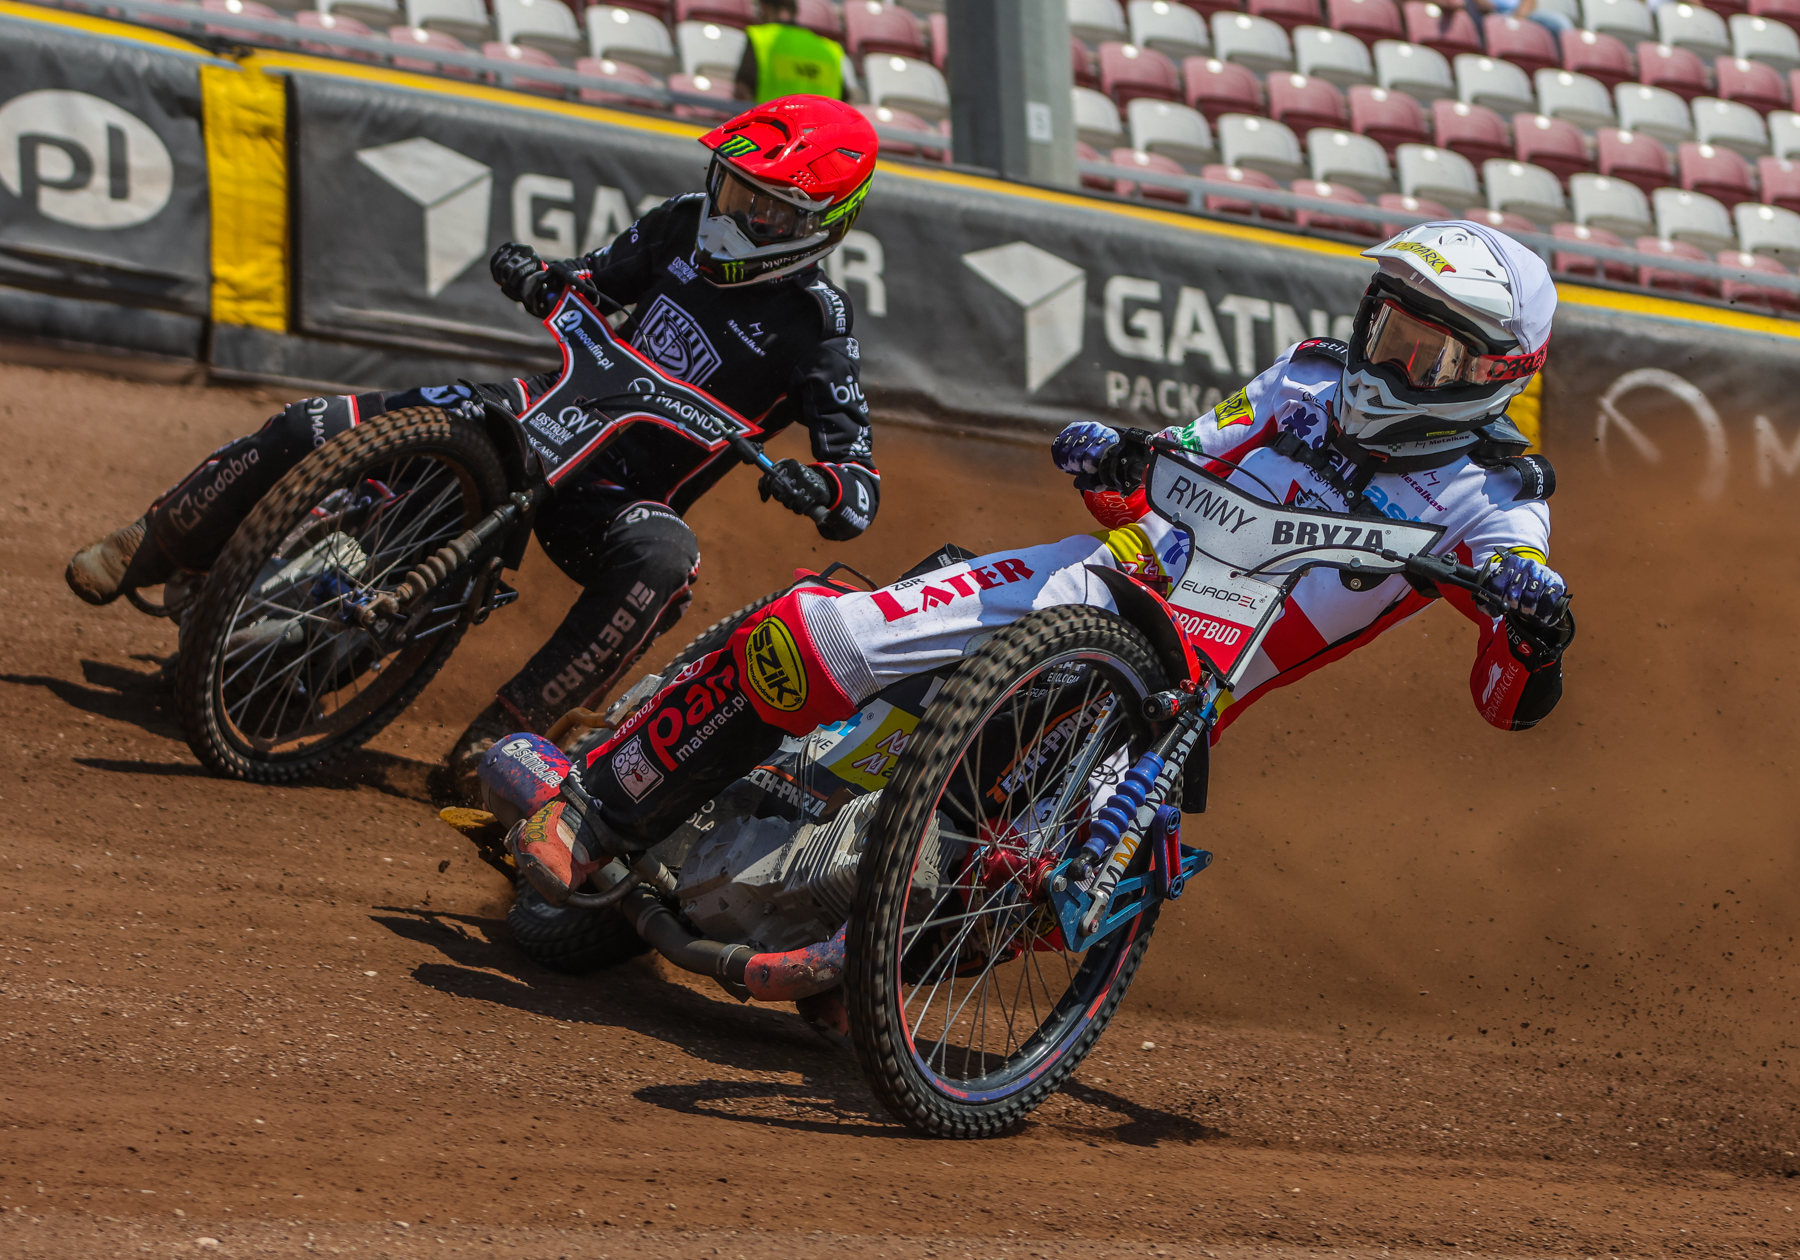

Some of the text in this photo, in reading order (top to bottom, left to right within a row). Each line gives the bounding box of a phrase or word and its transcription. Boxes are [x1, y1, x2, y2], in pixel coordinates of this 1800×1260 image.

[574, 326, 615, 371] moonfin.pl
[1103, 275, 1353, 379] GATN
[1166, 474, 1258, 535] RYNNY
[1271, 520, 1385, 551] BRYZA
[869, 558, 1035, 622] LATER
[890, 578, 926, 592] ZBR
[1180, 579, 1258, 610] EUROPEL
[541, 606, 638, 705] BETARD
[675, 690, 749, 762] materac.pl
